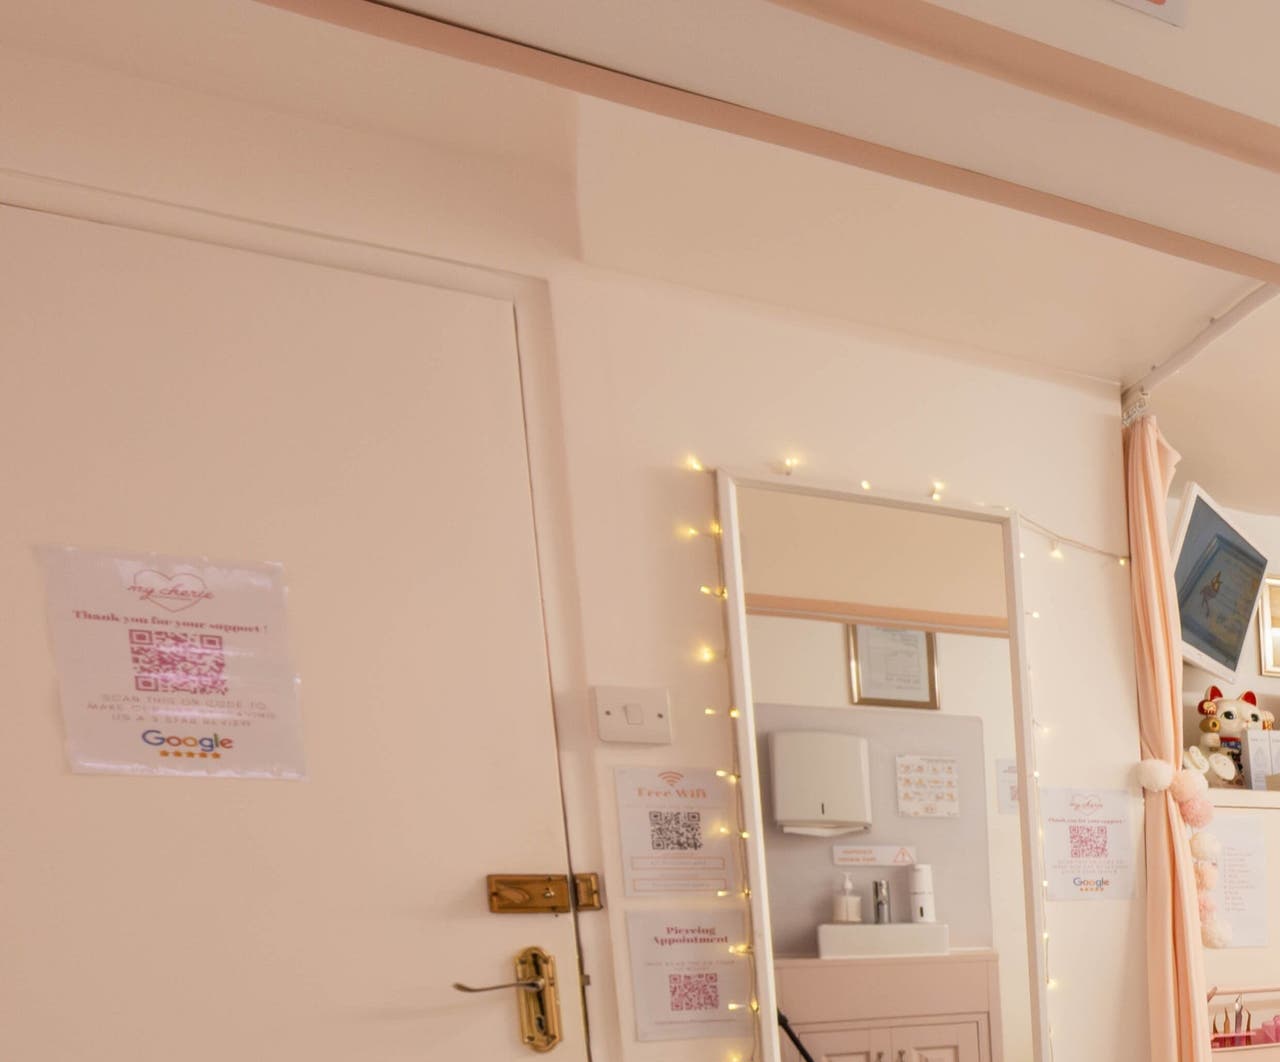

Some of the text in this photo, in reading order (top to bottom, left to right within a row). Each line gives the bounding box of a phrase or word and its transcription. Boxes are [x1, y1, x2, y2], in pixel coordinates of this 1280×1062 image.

[72, 610, 120, 623] Thank
[123, 615, 148, 626] you
[151, 616, 172, 626] for
[175, 619, 206, 629] your
[141, 729, 234, 752] Google
[637, 787, 673, 799] Free
[1073, 877, 1110, 888] Google
[665, 925, 717, 937] Piercing
[653, 935, 729, 947] Appointment
